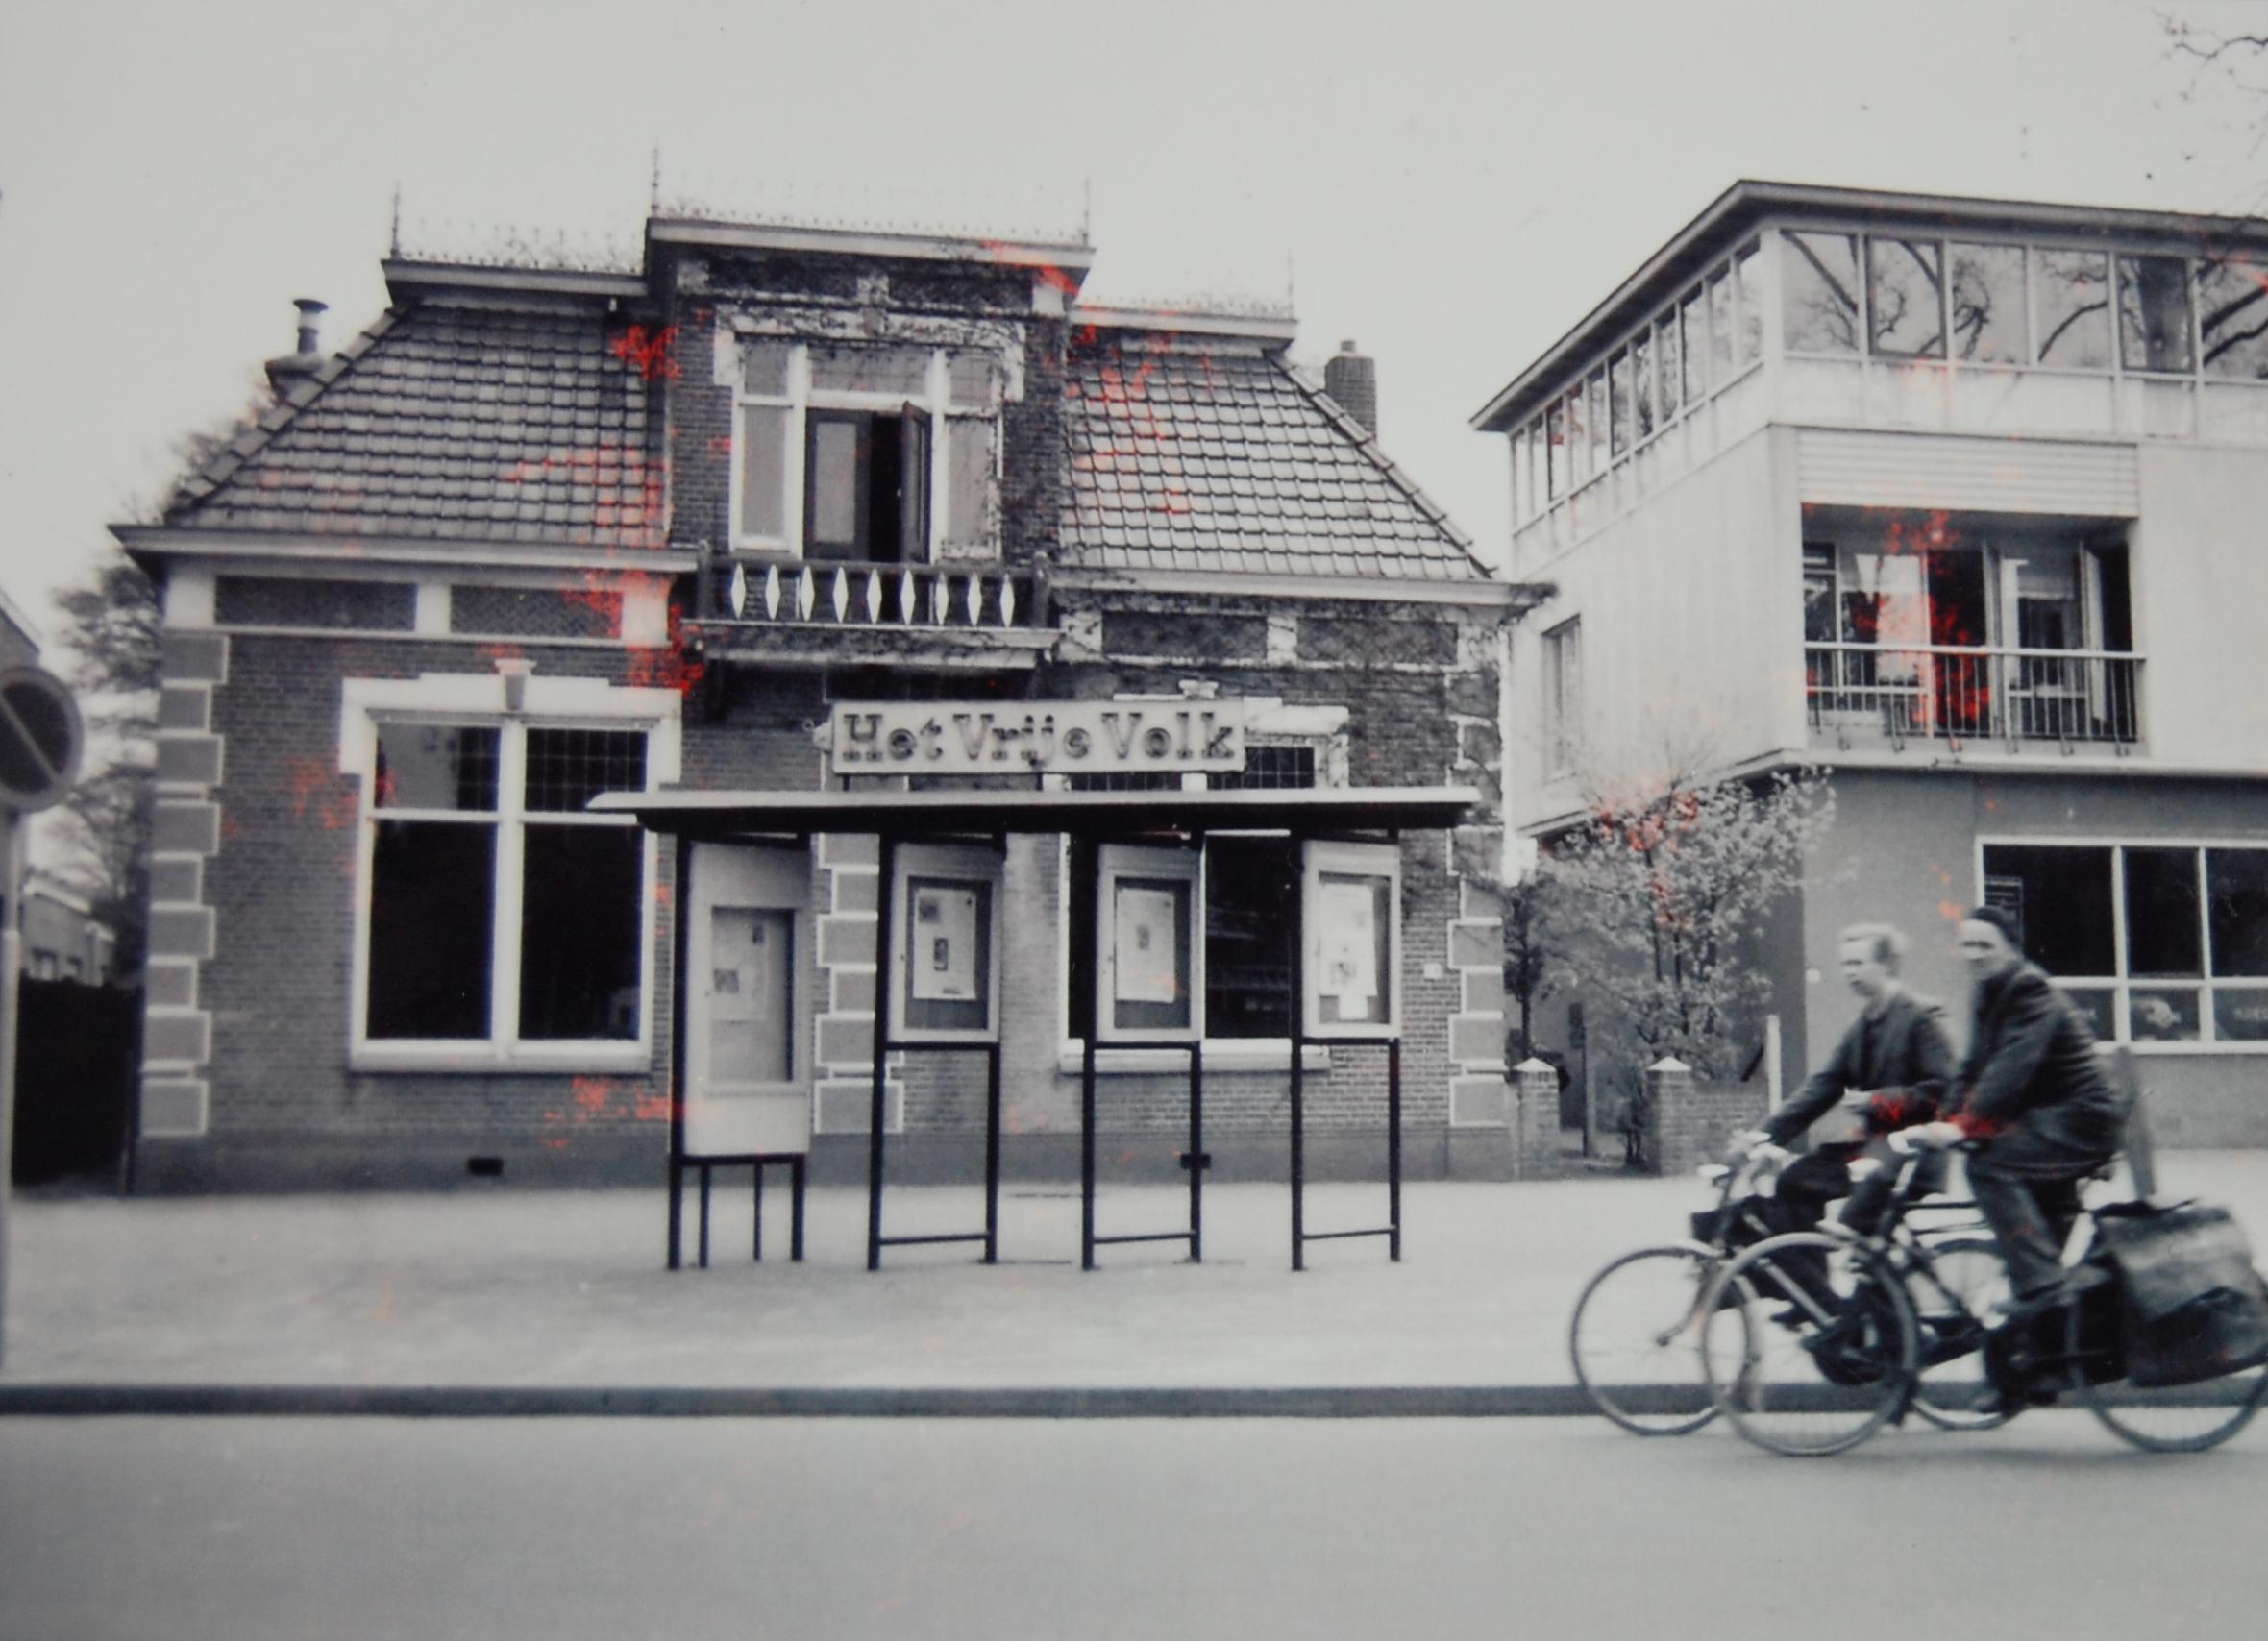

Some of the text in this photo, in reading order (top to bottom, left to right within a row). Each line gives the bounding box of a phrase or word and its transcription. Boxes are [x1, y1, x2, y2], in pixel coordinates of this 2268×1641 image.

[842, 711, 1236, 769] Het Vrije Volk
